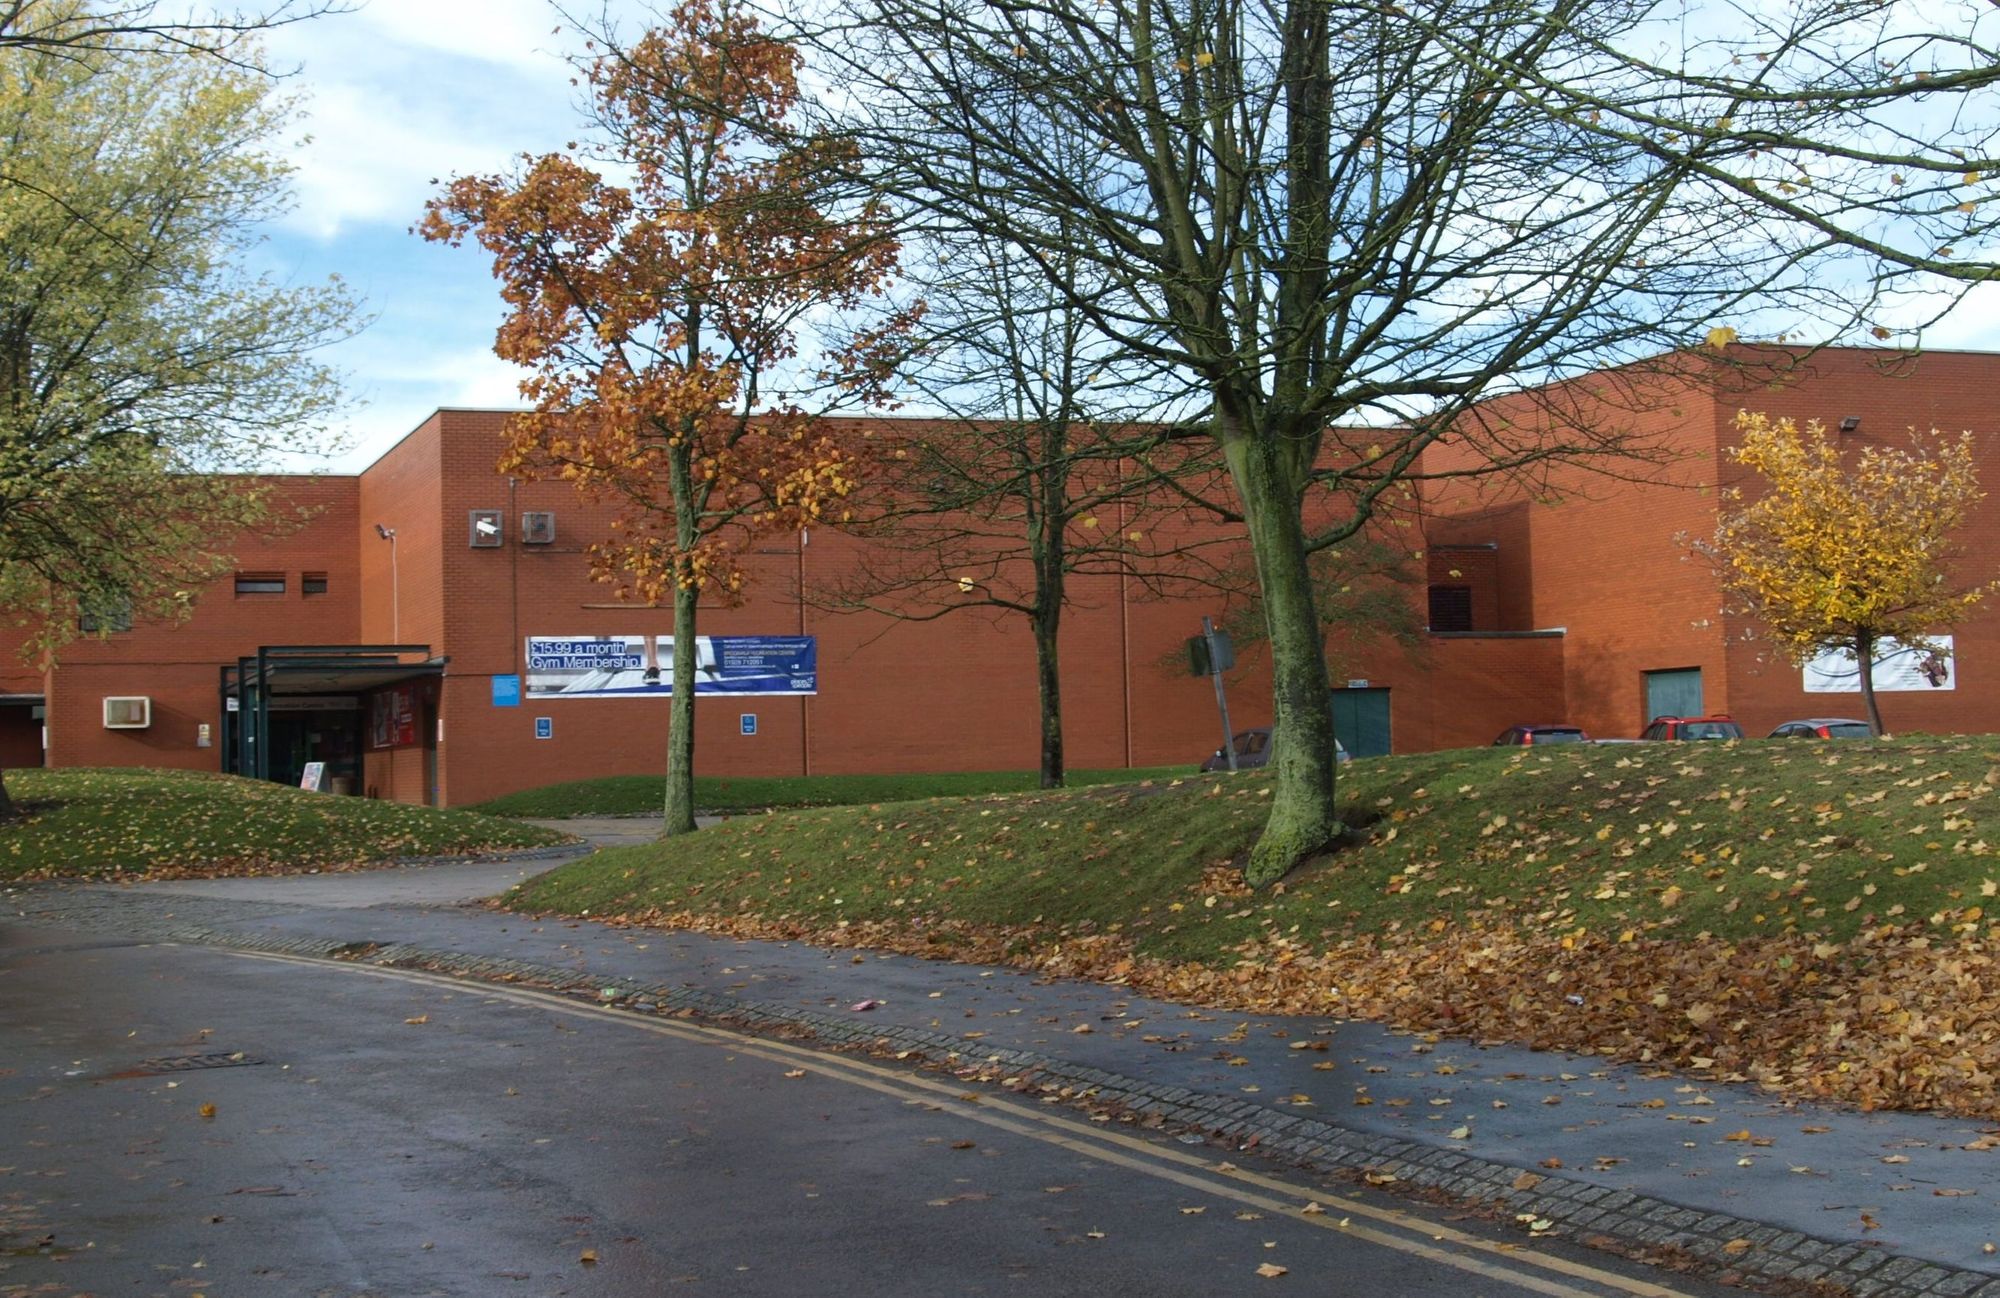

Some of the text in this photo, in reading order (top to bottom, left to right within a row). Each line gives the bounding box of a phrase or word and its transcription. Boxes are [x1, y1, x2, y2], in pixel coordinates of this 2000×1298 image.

[531, 642, 625, 654] £15.99 a month
[531, 656, 641, 671] Gym Membership.
